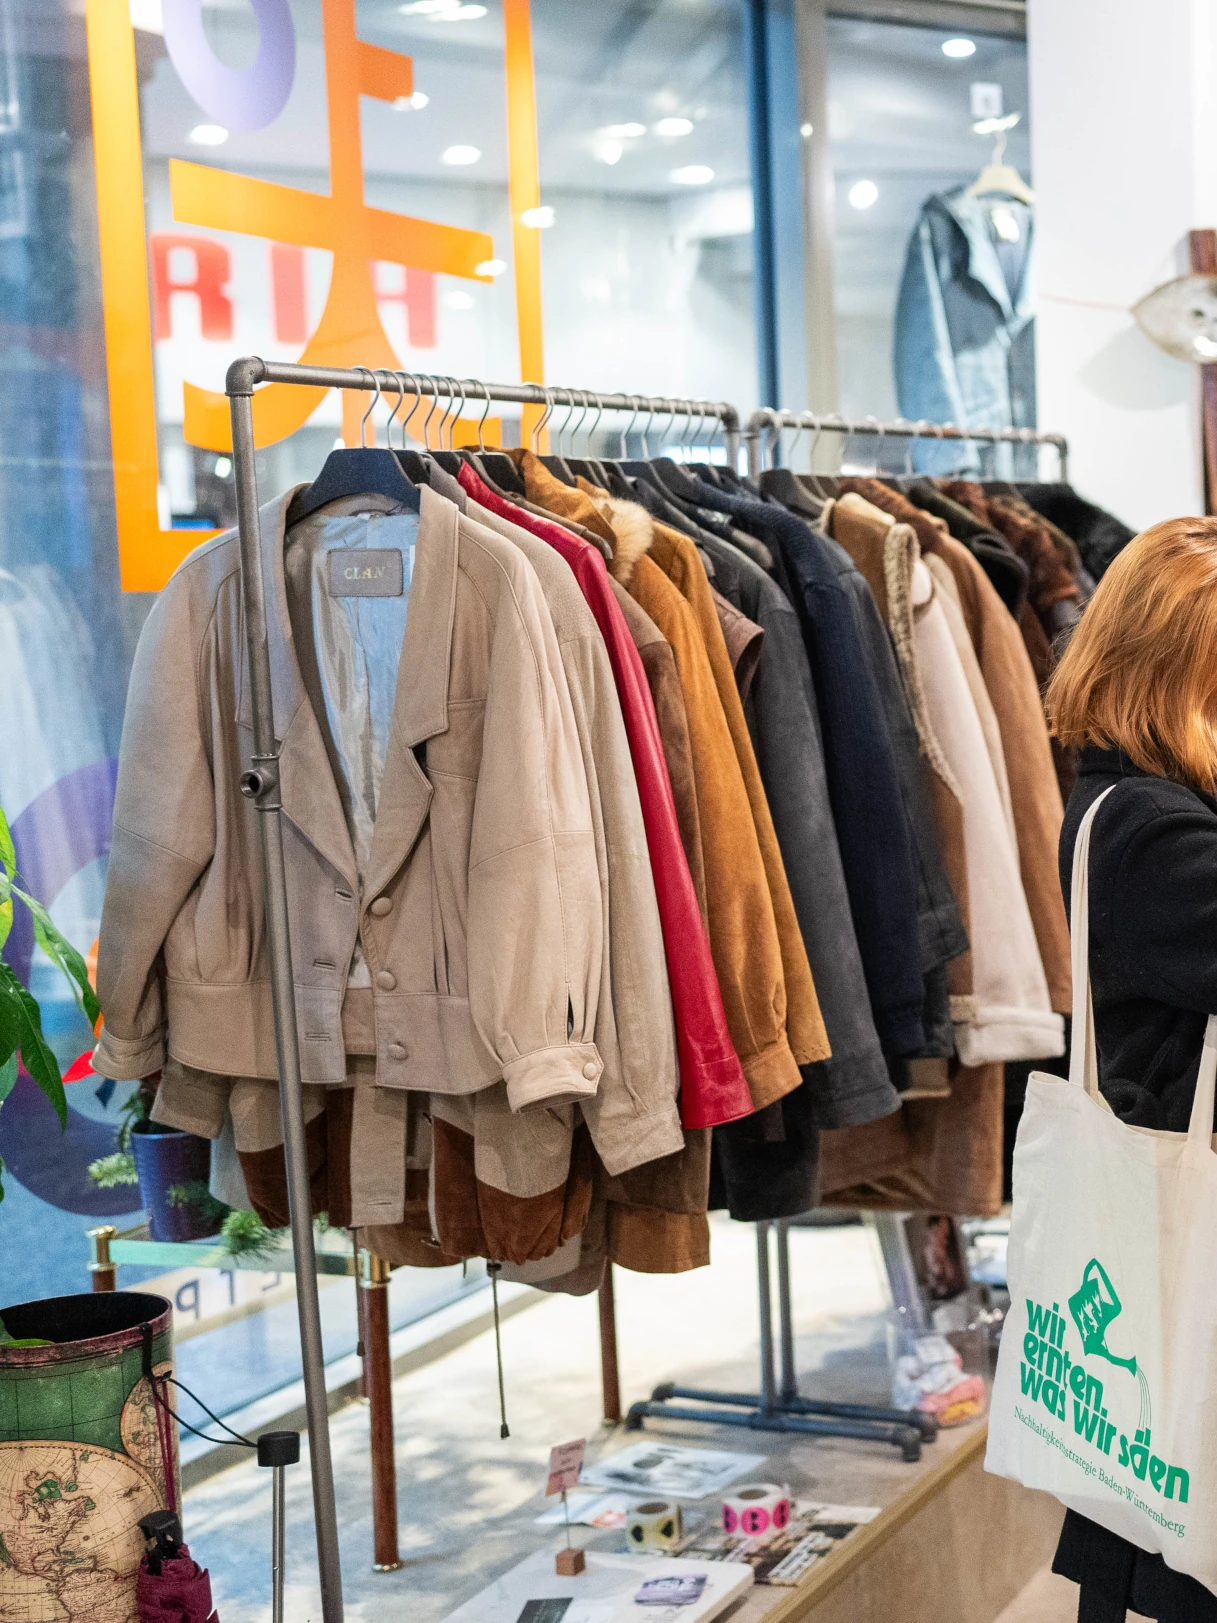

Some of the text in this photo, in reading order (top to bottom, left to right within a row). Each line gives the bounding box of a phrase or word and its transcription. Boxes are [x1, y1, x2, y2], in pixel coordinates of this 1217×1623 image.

[343, 566, 386, 580] CLAN
[1026, 1298, 1067, 1350] wir
[1023, 1332, 1104, 1412] ernten
[1020, 1361, 1190, 1504] was wir säen
[1098, 1467, 1186, 1538] Baden-Württemberg
